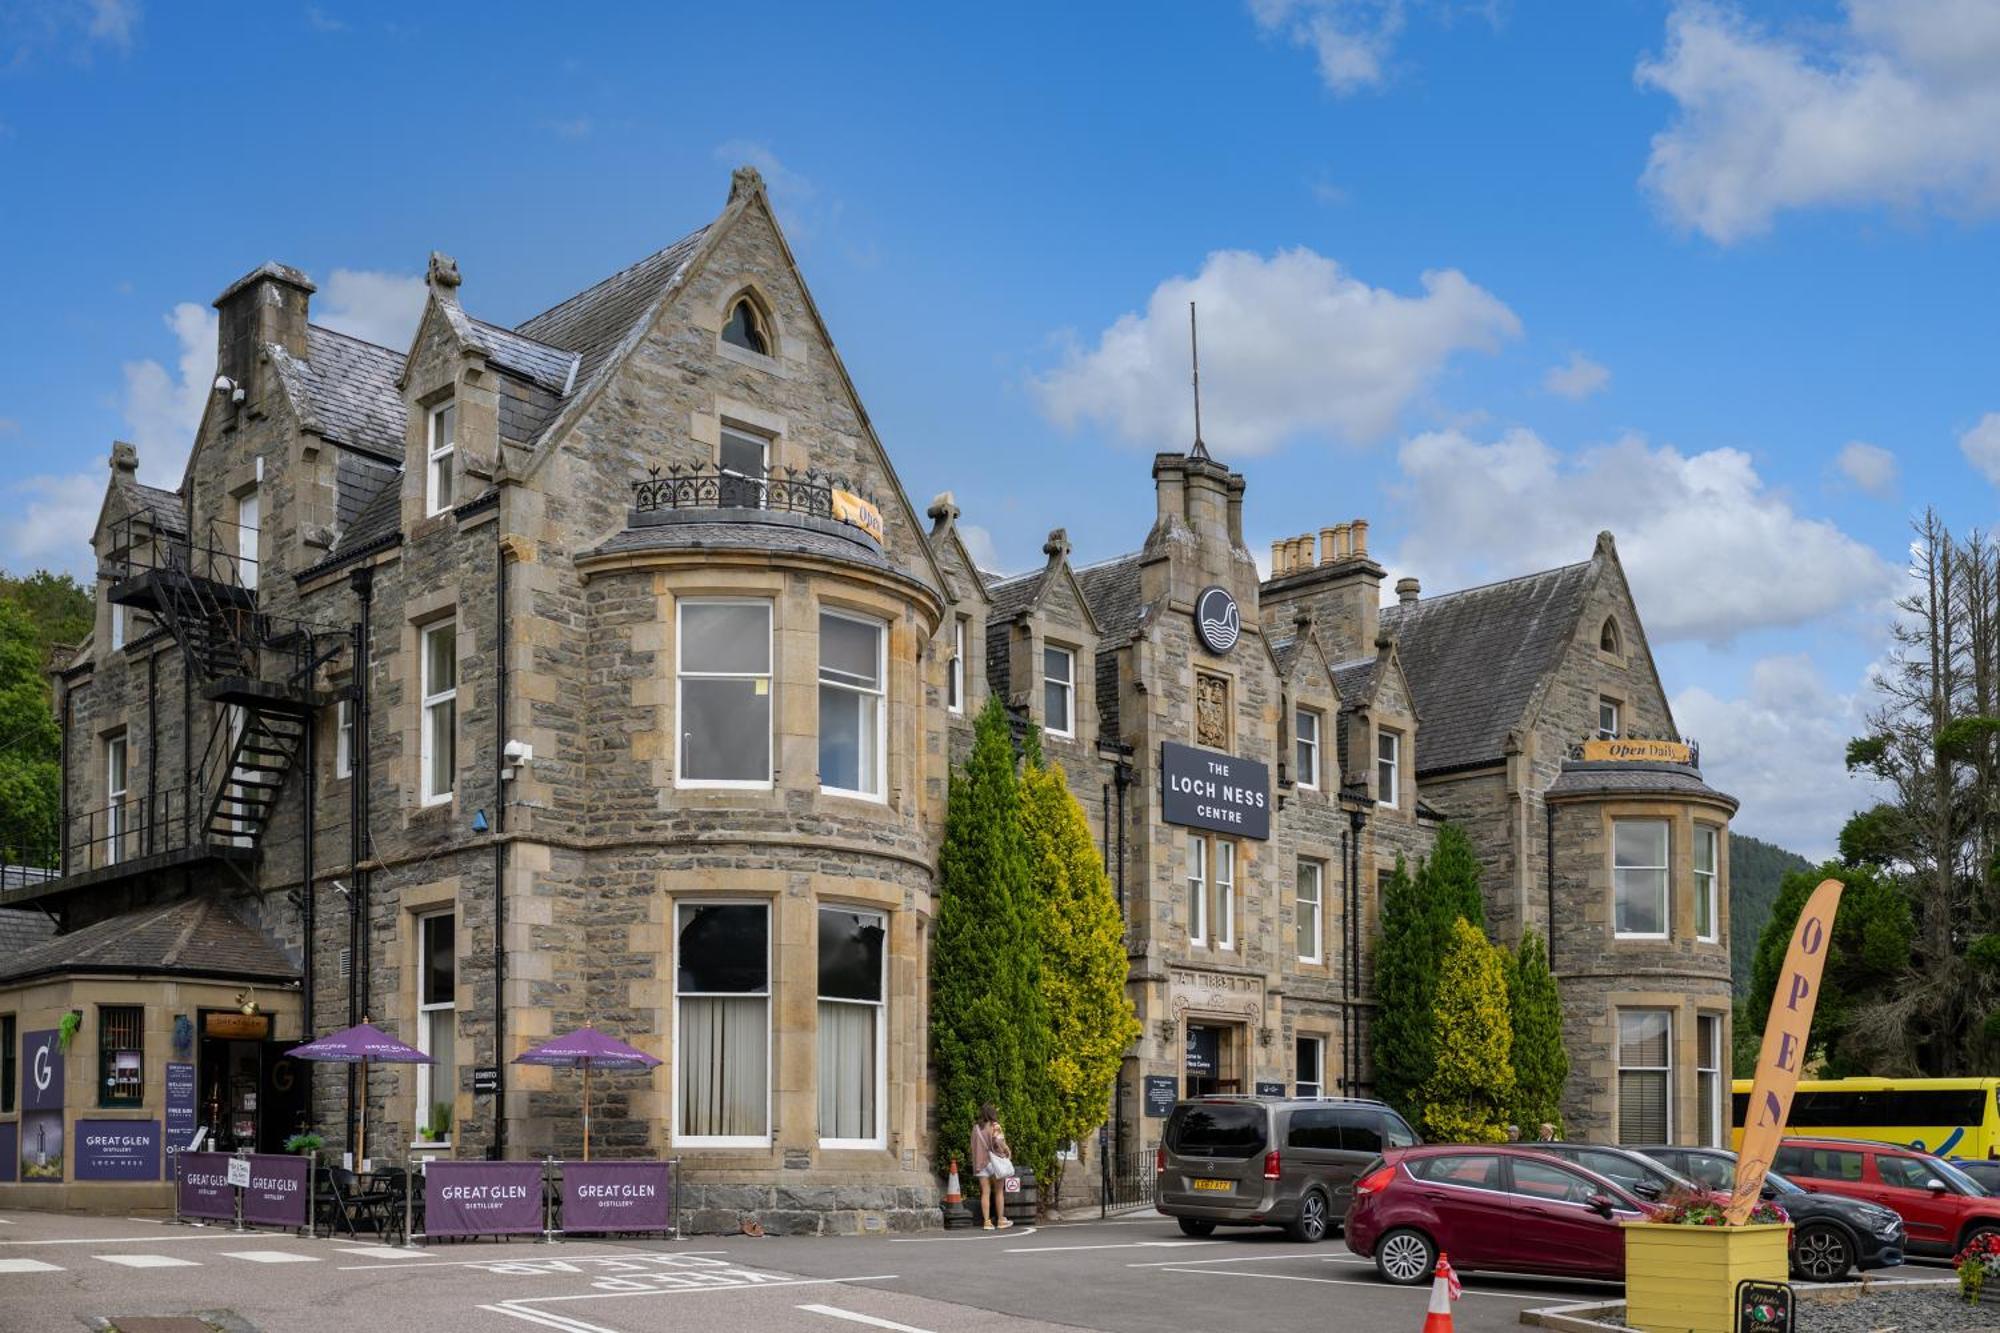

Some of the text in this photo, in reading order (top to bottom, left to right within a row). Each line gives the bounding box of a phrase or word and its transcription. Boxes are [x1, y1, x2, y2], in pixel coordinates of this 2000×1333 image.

[1609, 744, 1676, 758] Open Daily
[1208, 762, 1229, 777] THE
[1171, 774, 1264, 808] LOCH NESS
[1197, 804, 1242, 824] CENTRE
[1757, 916, 1823, 1128] OPEN
[34, 1043, 52, 1094] G
[272, 1060, 295, 1091] G
[86, 1135, 150, 1146] GREAT GLEN
[187, 1173, 229, 1187] GREAT GLEN
[252, 1177, 298, 1191] GREAT GLEN
[442, 1185, 526, 1199] GREAT GLEN
[578, 1184, 655, 1197] GREAT GLEN
[463, 1256, 731, 1275] CLEAR
[591, 1269, 792, 1291] KEEP
